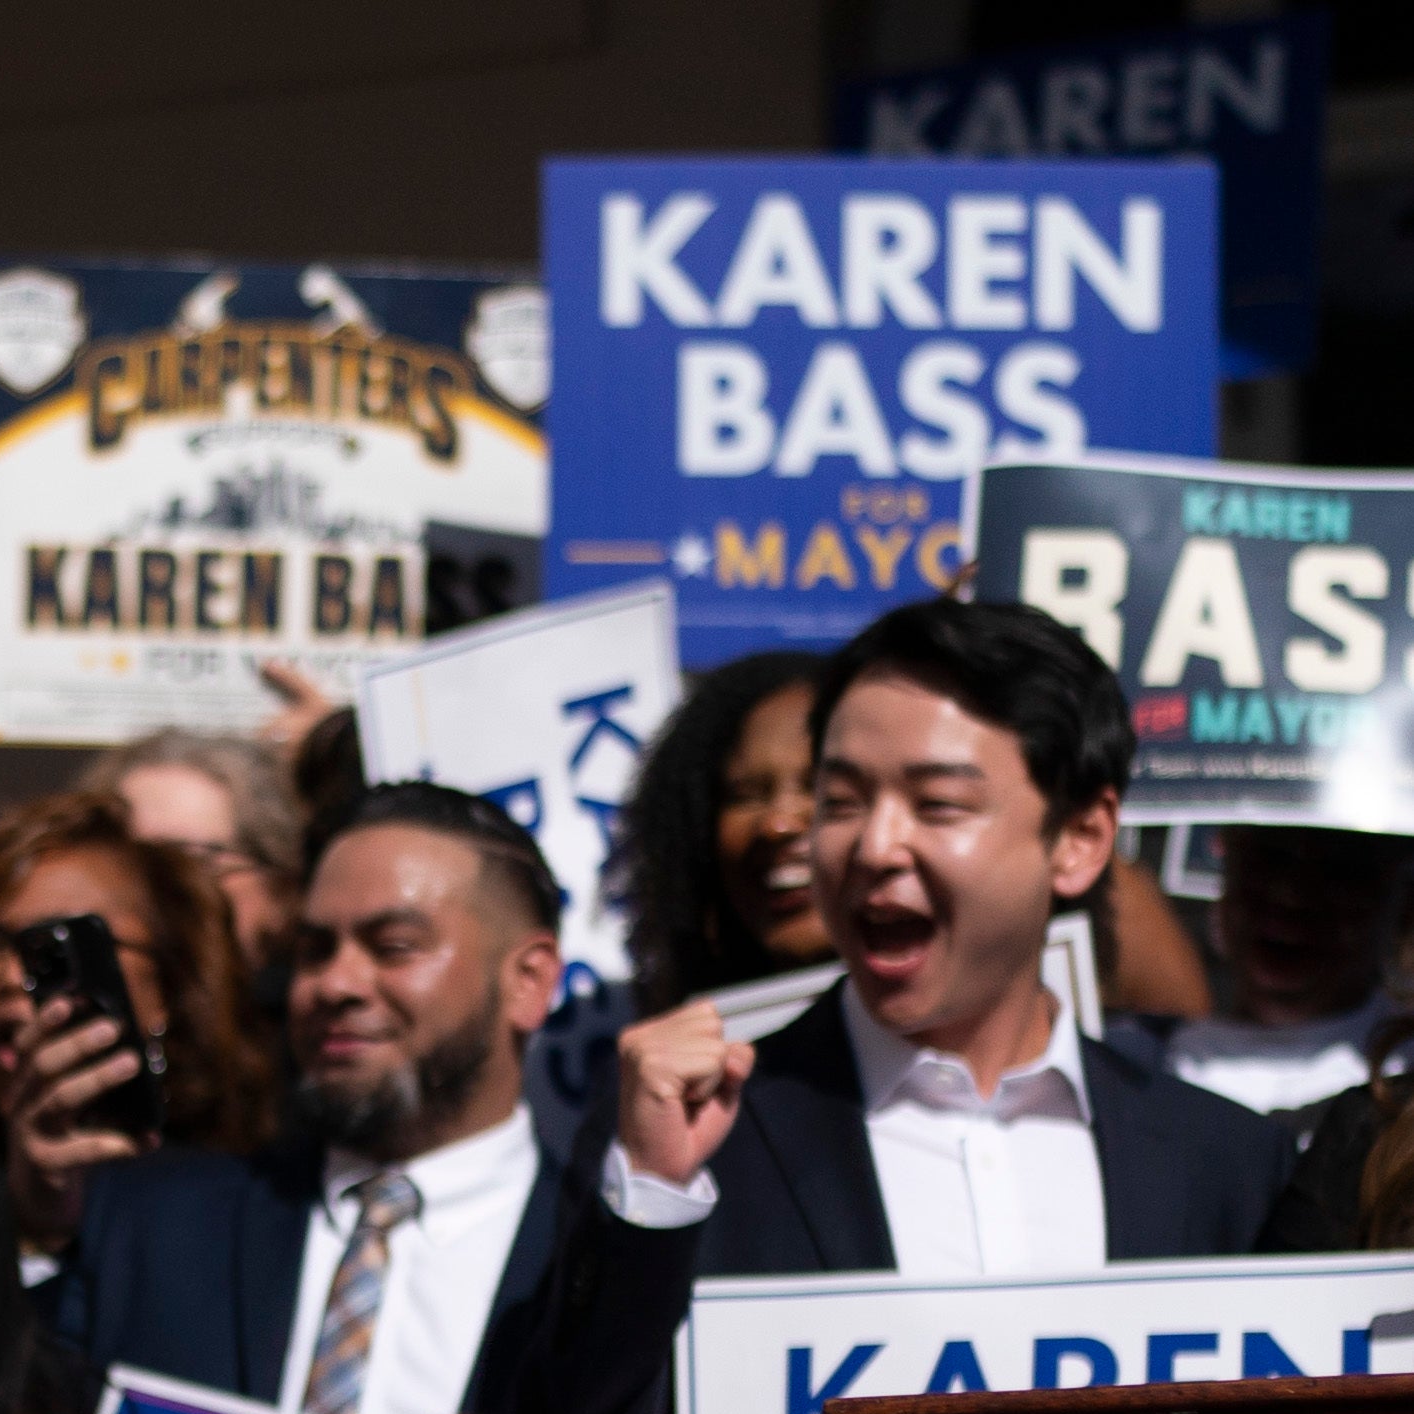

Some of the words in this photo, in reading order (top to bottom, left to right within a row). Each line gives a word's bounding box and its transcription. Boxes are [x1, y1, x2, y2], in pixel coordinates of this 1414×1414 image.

[870, 38, 1290, 156] KAREN
[600, 193, 1164, 332] KAREN
[676, 341, 1087, 480] BASS
[713, 519, 966, 591] MAYO
[1181, 484, 1355, 543] KAREN
[22, 541, 284, 638] KAREN
[1020, 528, 1414, 698] BAS
